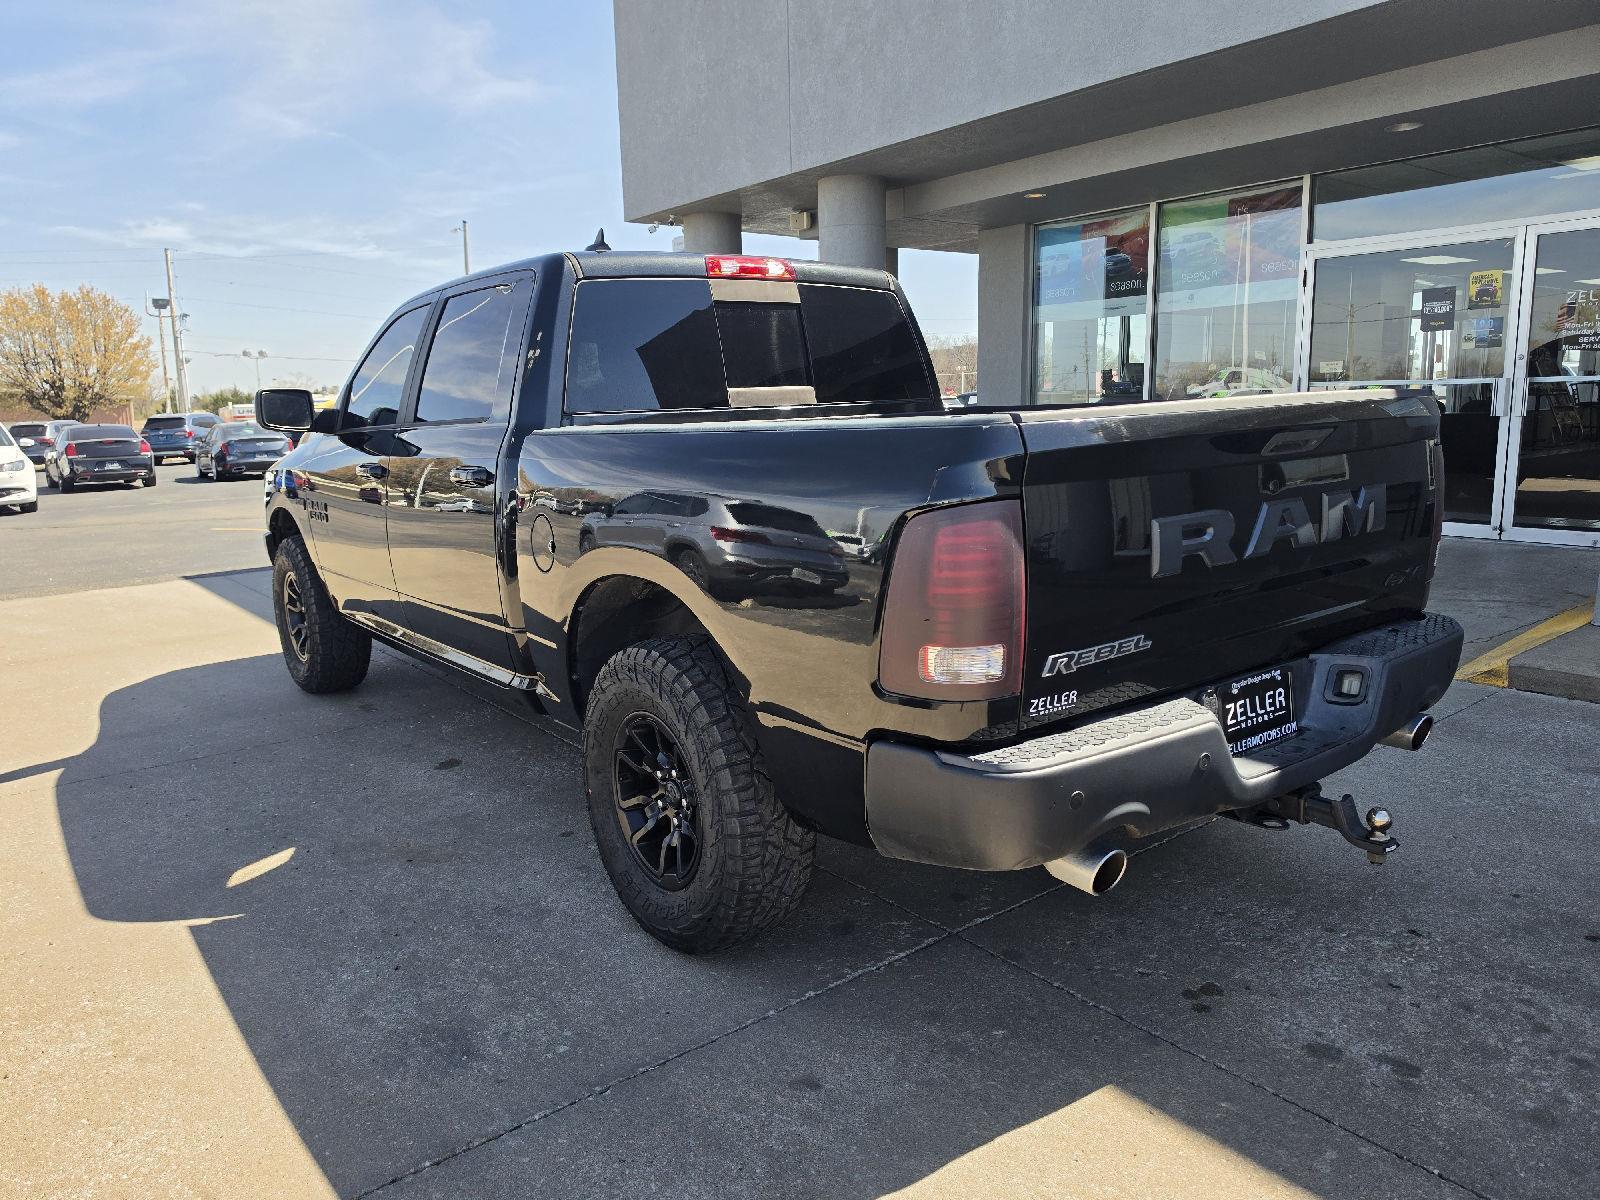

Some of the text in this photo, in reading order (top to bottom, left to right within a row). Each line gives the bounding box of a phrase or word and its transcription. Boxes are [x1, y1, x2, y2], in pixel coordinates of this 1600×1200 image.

[1151, 483, 1387, 579] RAM
[1041, 634, 1153, 678] REBEL
[1029, 690, 1078, 713] ZELLER
[1225, 687, 1286, 726] ZELLER
[1228, 720, 1298, 755] ELLERMOTORS.COM
[1240, 712, 1274, 729] MOTORS
